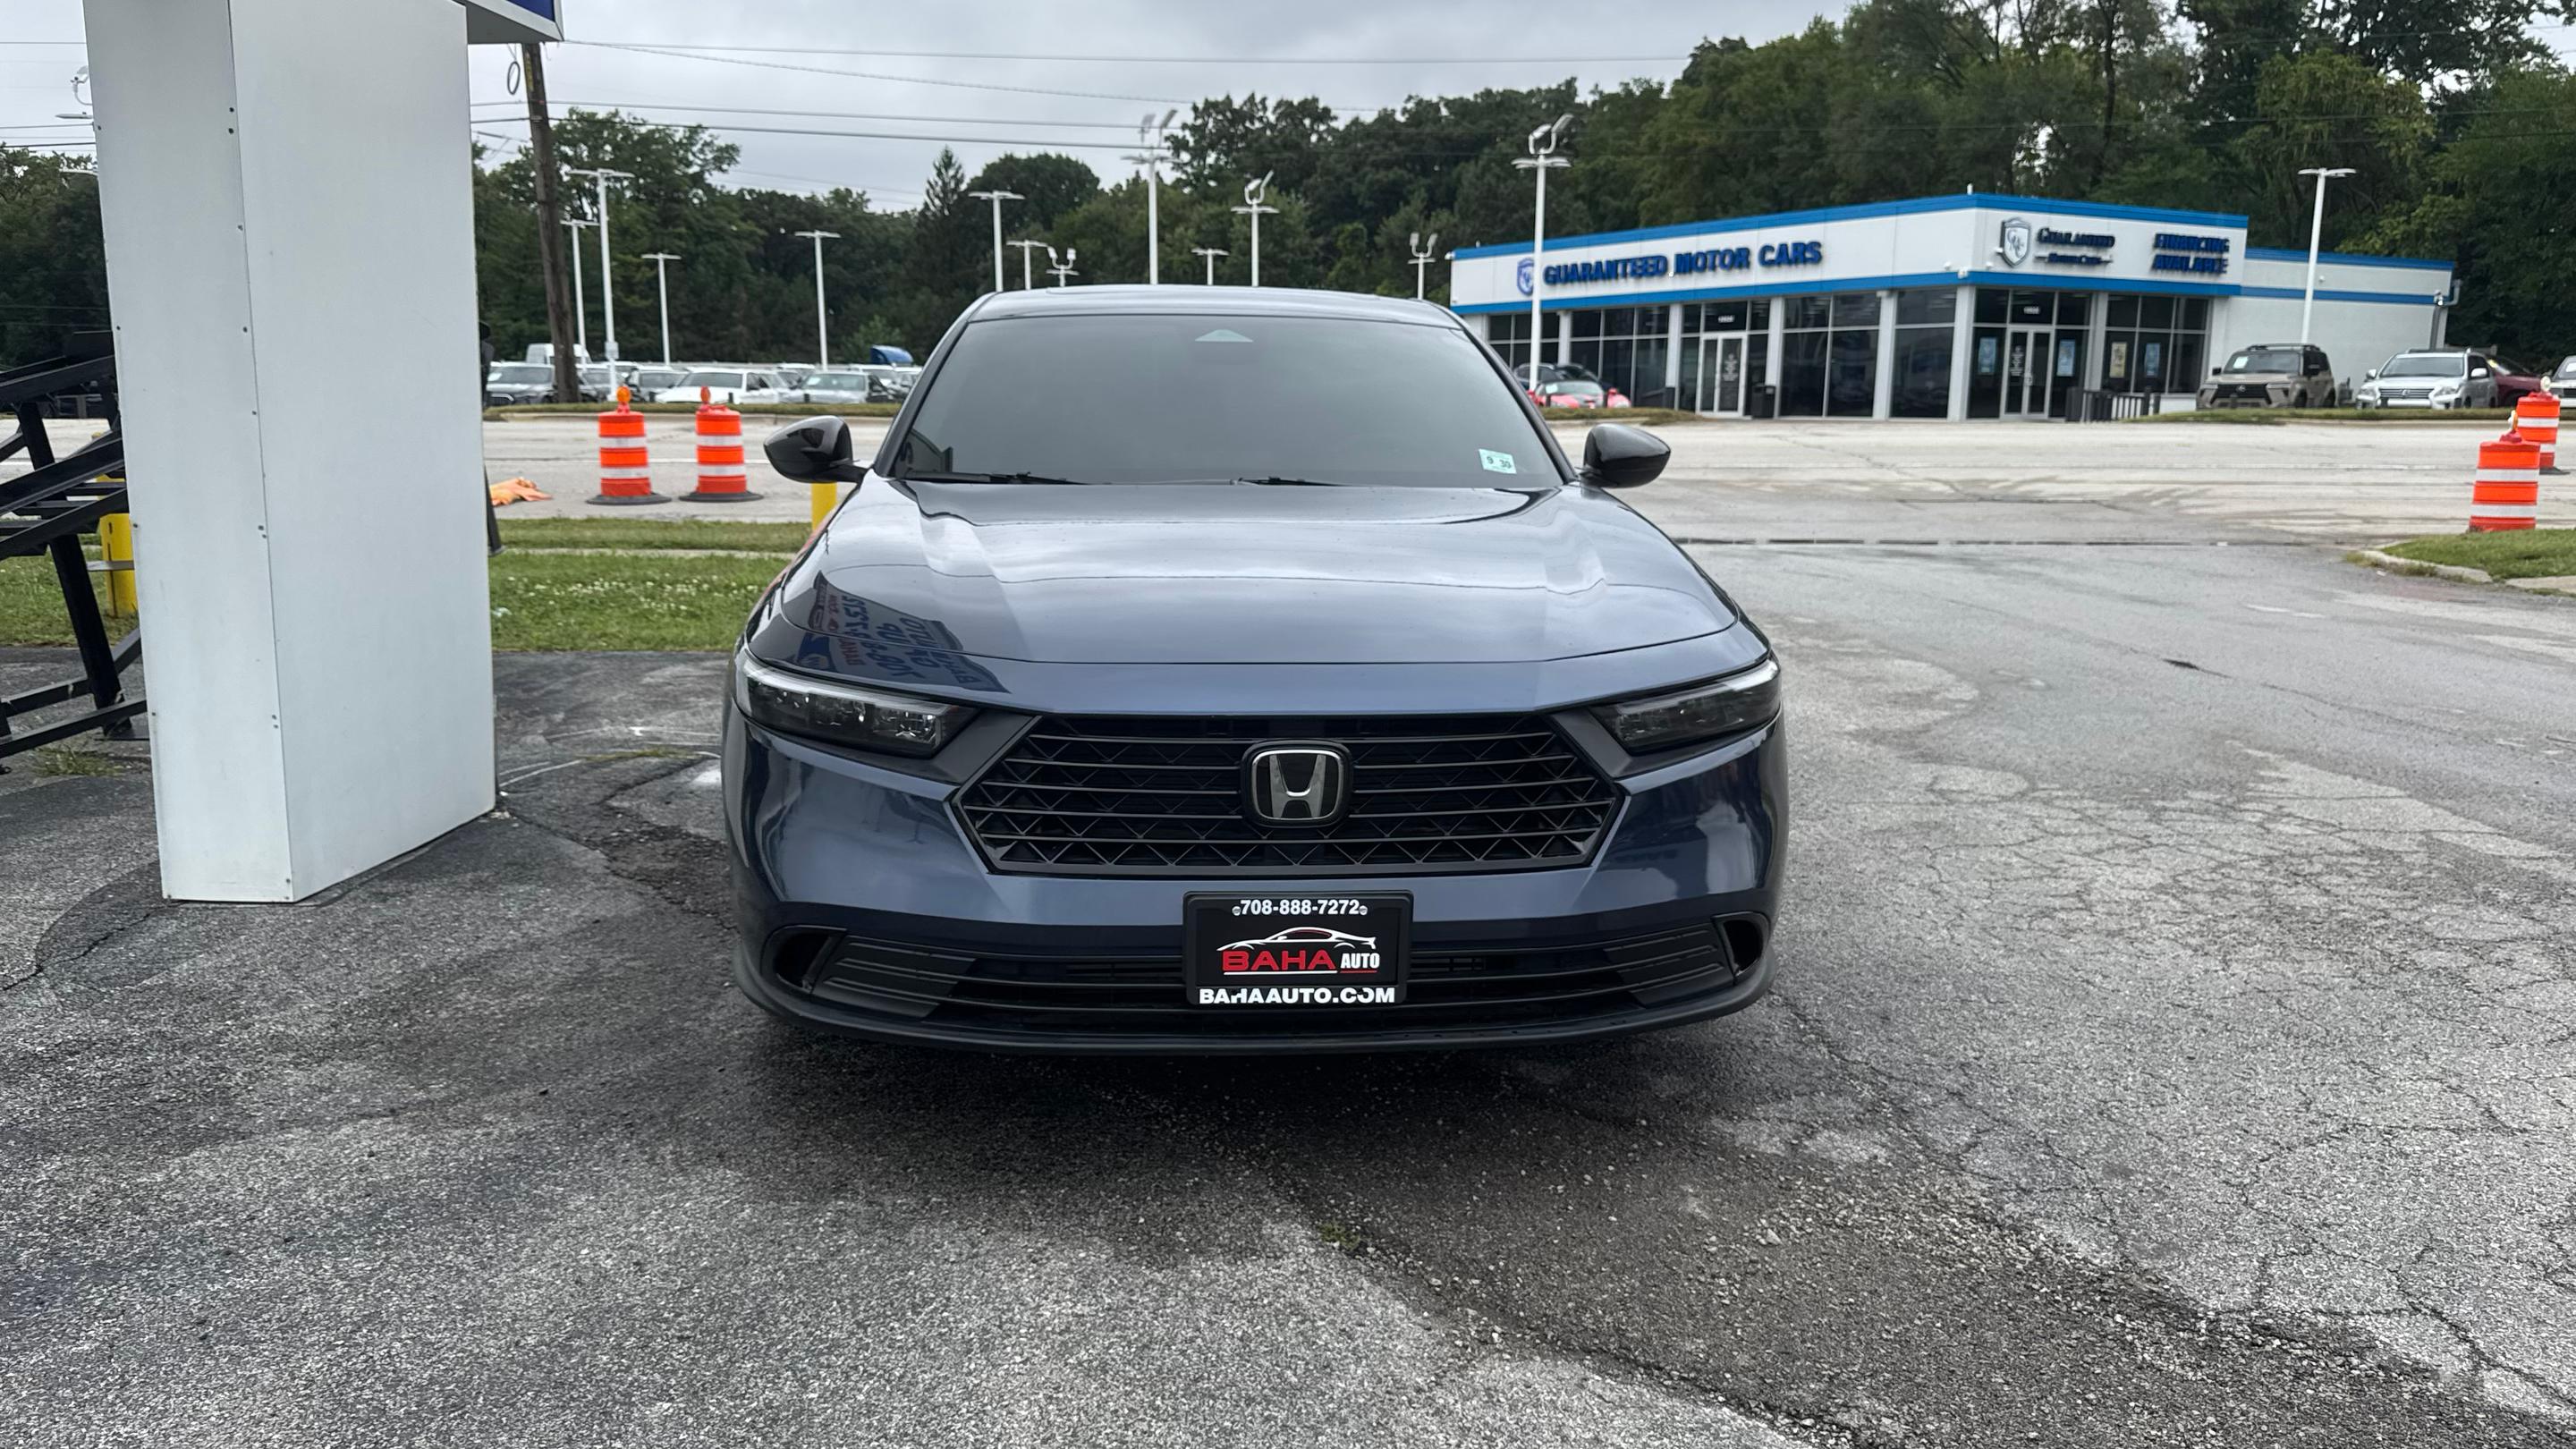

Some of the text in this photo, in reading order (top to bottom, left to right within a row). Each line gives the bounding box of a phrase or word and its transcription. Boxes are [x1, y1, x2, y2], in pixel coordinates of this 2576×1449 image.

[1544, 241, 1823, 285] GUARANTEED MOTOR CARS
[1240, 899, 1360, 916] 708-888-7272
[1222, 949, 1380, 971] BAHA AUTO
[1199, 987, 1395, 1004] BAHAAUTO.COM
